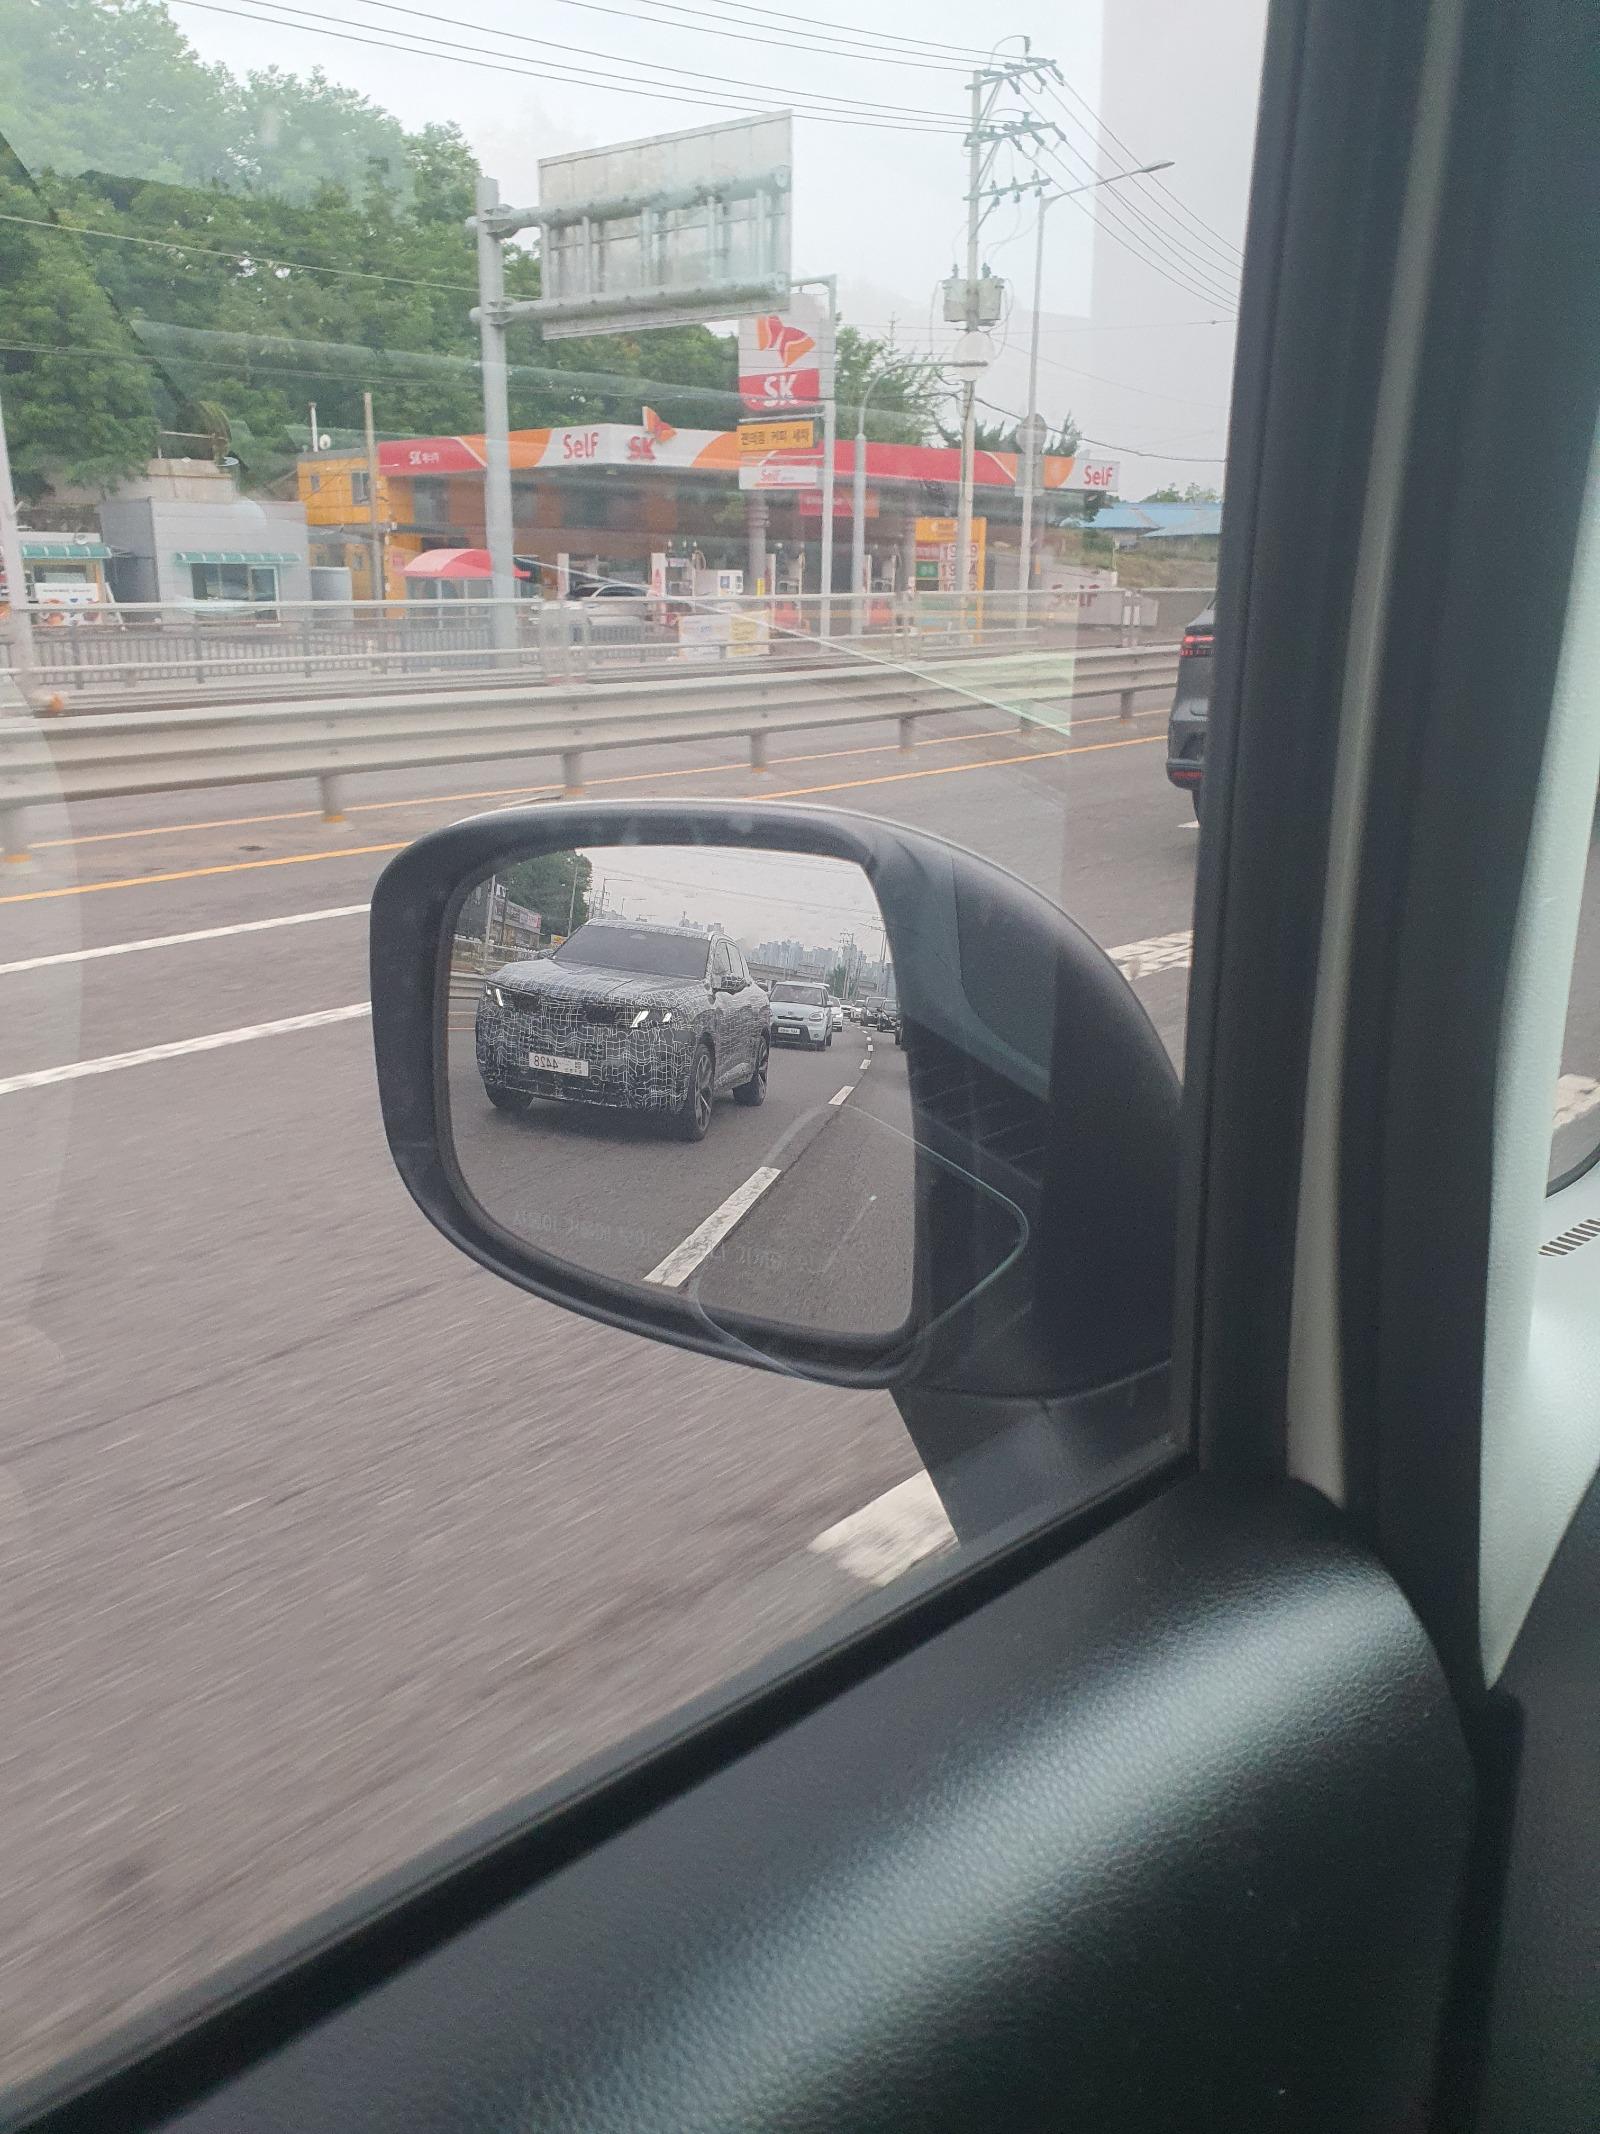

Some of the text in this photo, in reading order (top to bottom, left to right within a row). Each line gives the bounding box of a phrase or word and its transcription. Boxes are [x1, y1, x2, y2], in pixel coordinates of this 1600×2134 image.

[763, 374, 799, 408] SK
[562, 432, 599, 460] Self
[627, 436, 657, 460] SK
[1083, 464, 1114, 486] Self
